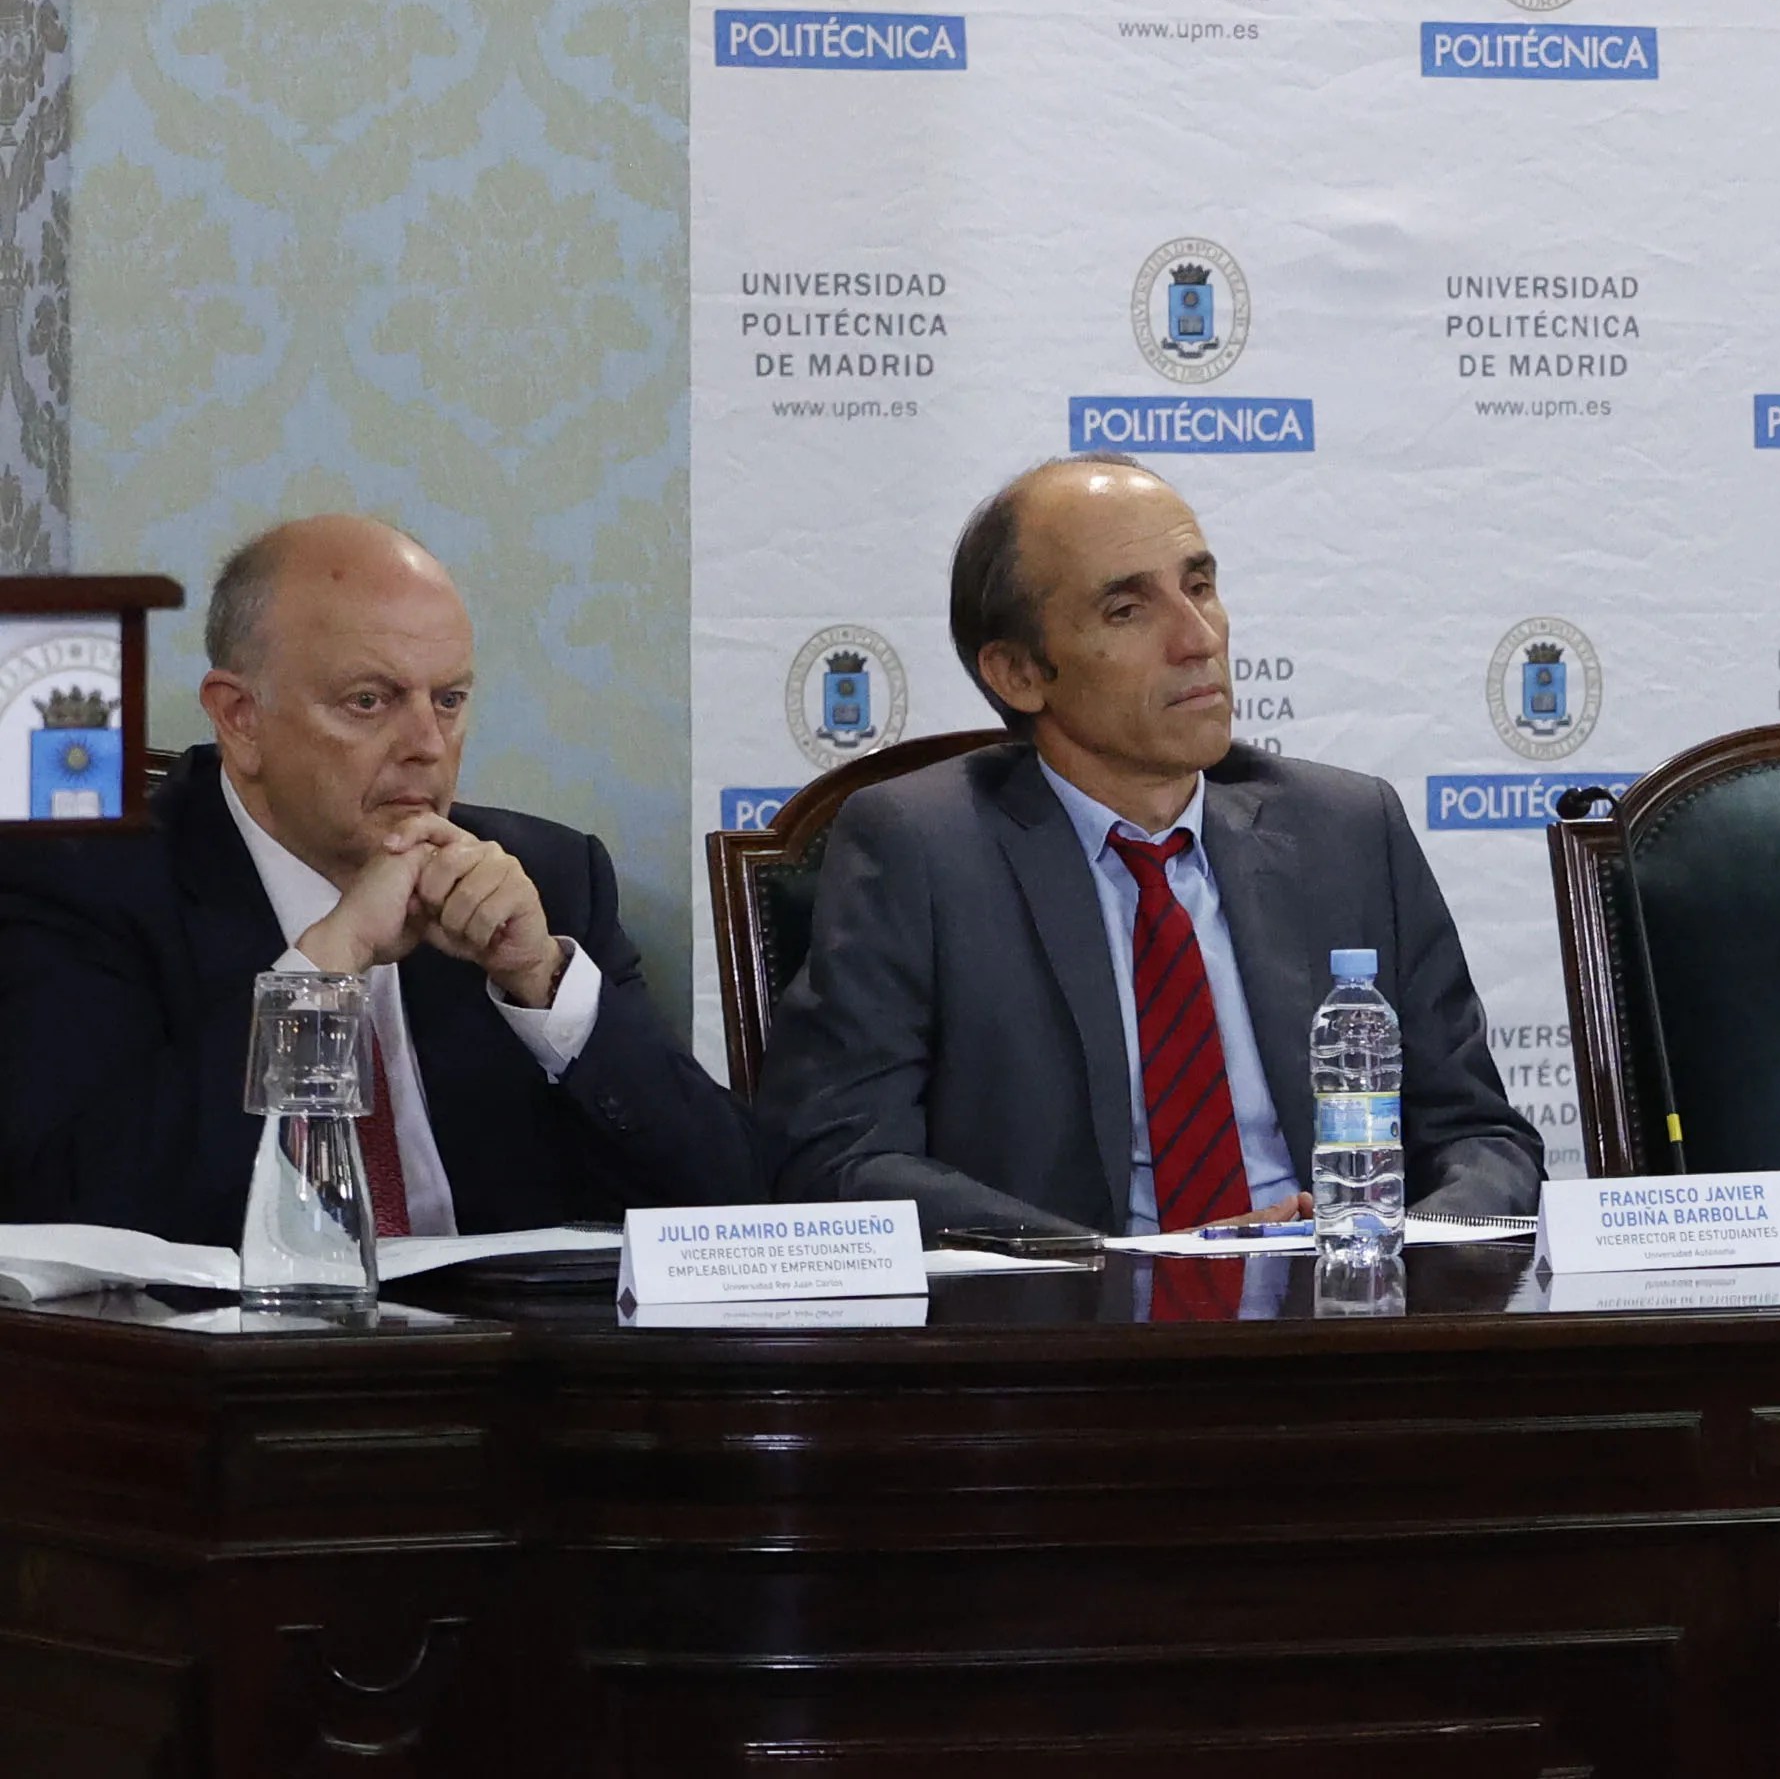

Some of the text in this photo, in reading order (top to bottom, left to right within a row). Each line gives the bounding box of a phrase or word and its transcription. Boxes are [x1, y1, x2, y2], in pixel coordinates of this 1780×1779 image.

[729, 16, 957, 64] POLITÉCNICA
[1119, 23, 1258, 42] www.upm.es
[1435, 28, 1648, 73] POLITÉCNICA
[743, 273, 945, 296] UNIVERSIDAD
[1448, 276, 1638, 299] UNIVERSIDAD
[742, 308, 946, 336] POLITÉCNICA
[1447, 311, 1639, 338] POLITÉCNICA
[756, 354, 933, 376] DE MADRID
[1460, 355, 1627, 377] DE MADRID
[773, 401, 917, 420] www.upm.es
[1475, 401, 1611, 418] www.upm.es
[1084, 402, 1303, 442] POLITÉCNICA
[1599, 1184, 1765, 1207] FRANCISCO JAVIER
[1674, 1205, 1769, 1225] BARBOLLA
[658, 1215, 895, 1243] JULIO RAMIRO BARGUEÑO
[1595, 1226, 1779, 1247] VICERRECTOR DE ESTUDIANTES
[680, 1242, 877, 1261] VICERRECTOR DE ESTUDIANTES,
[668, 1257, 893, 1278] EMPLEABILIDAD Y EMPRENDIMIENTO
